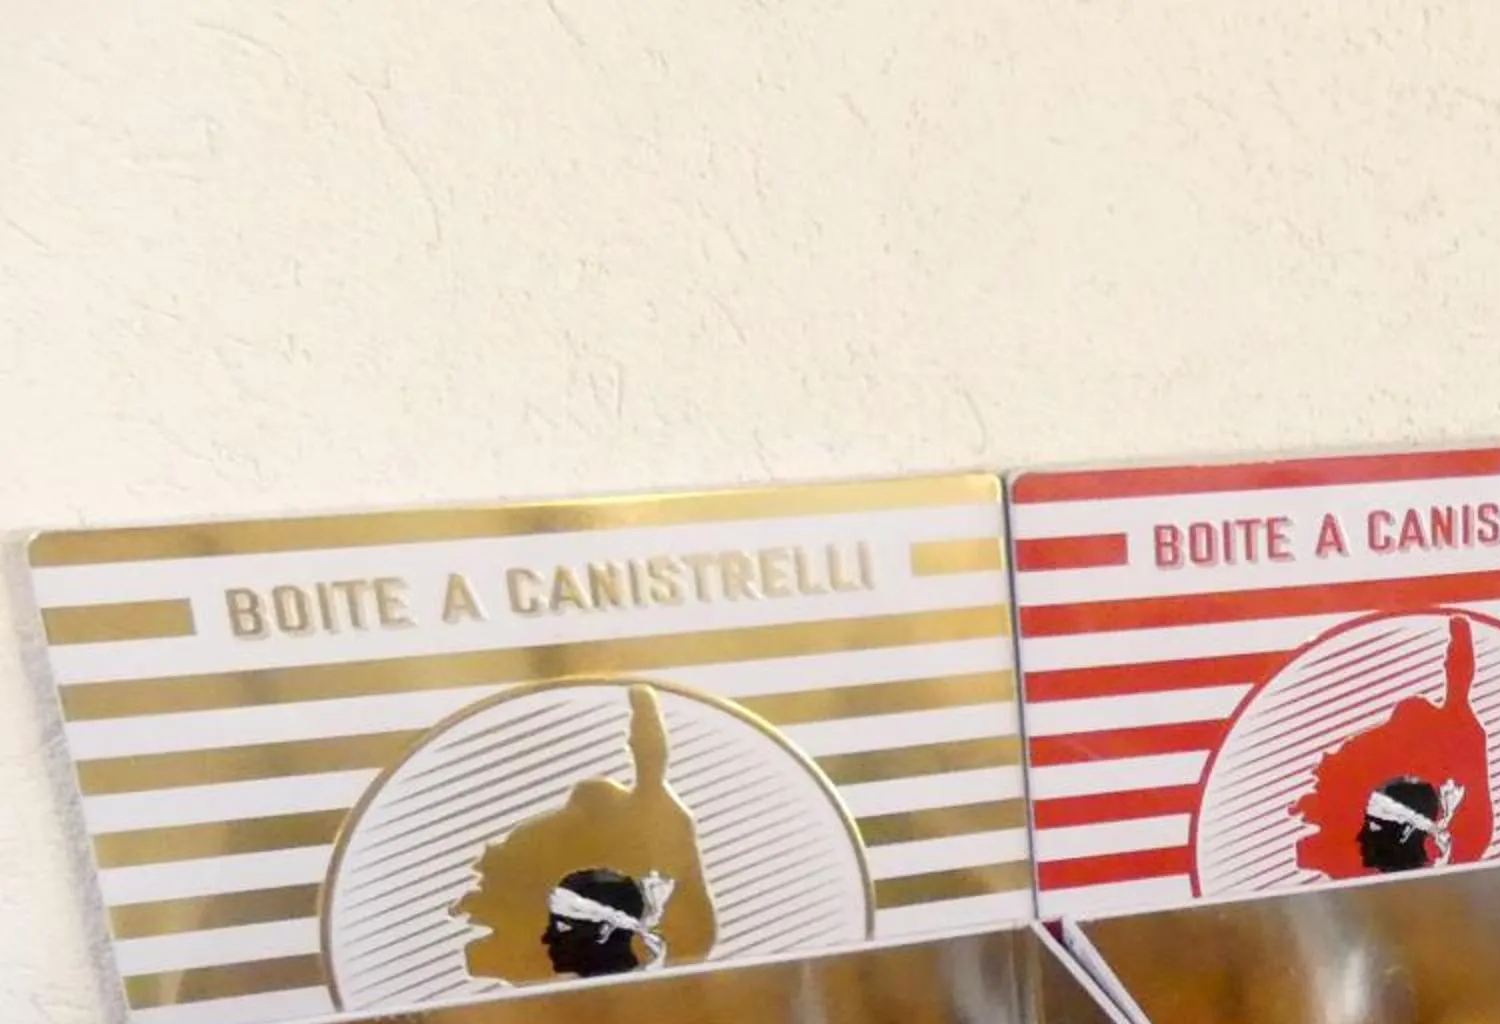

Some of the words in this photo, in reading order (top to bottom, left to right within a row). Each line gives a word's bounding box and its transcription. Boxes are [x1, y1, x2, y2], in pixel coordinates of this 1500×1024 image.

[1154, 516, 1294, 568] BOITE
[1315, 513, 1349, 557] A
[225, 575, 416, 640] BOITE
[441, 572, 490, 624] A
[507, 541, 875, 618] CANISTRELLI
